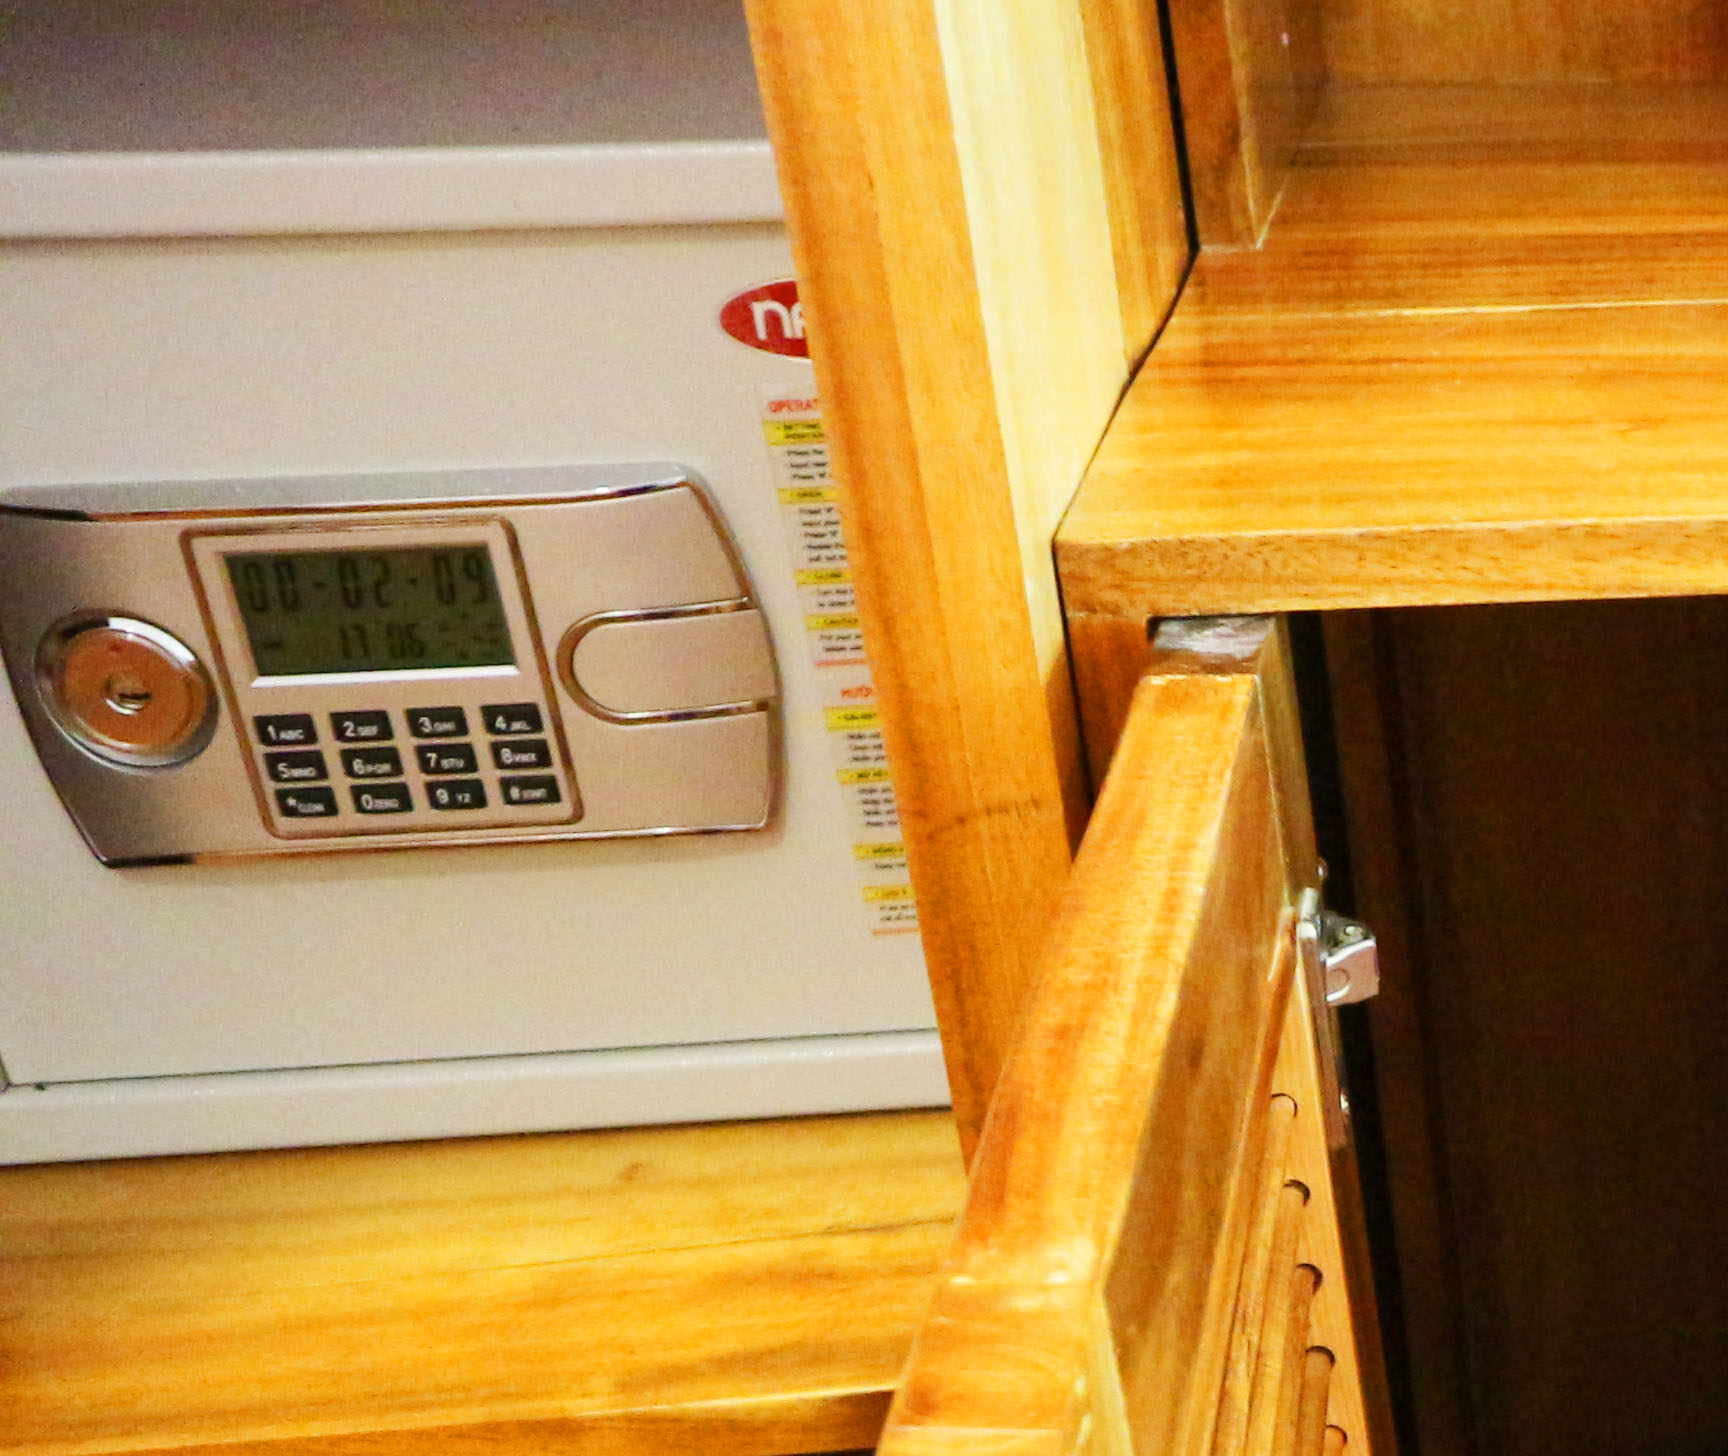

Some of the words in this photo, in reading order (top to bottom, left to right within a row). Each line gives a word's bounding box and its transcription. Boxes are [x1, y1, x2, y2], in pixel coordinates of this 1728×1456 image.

[343, 720, 356, 737] 2
[418, 716, 433, 733] 3
[495, 715, 506, 731] 4
[267, 725, 278, 741] 1
[426, 752, 438, 768] 7
[501, 747, 514, 764] 8
[277, 763, 290, 778] 5
[352, 758, 365, 775] 6
[436, 788, 449, 804] 9
